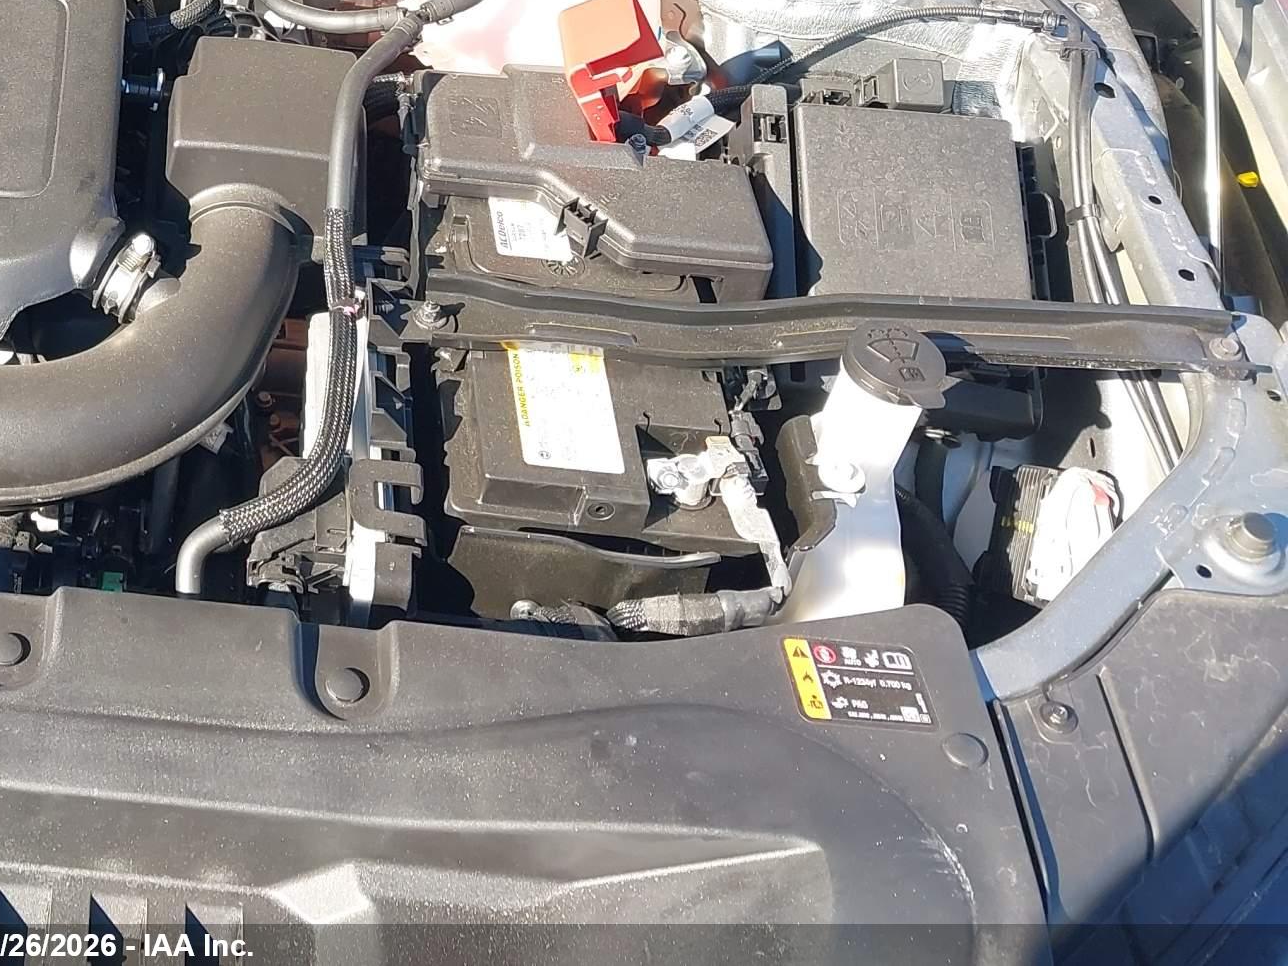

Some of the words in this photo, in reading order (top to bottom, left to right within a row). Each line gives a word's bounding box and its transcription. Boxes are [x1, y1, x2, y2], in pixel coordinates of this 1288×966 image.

[497, 210, 509, 249] ACDelco
[514, 352, 524, 383] POISON
[518, 386, 530, 420] DANGER
